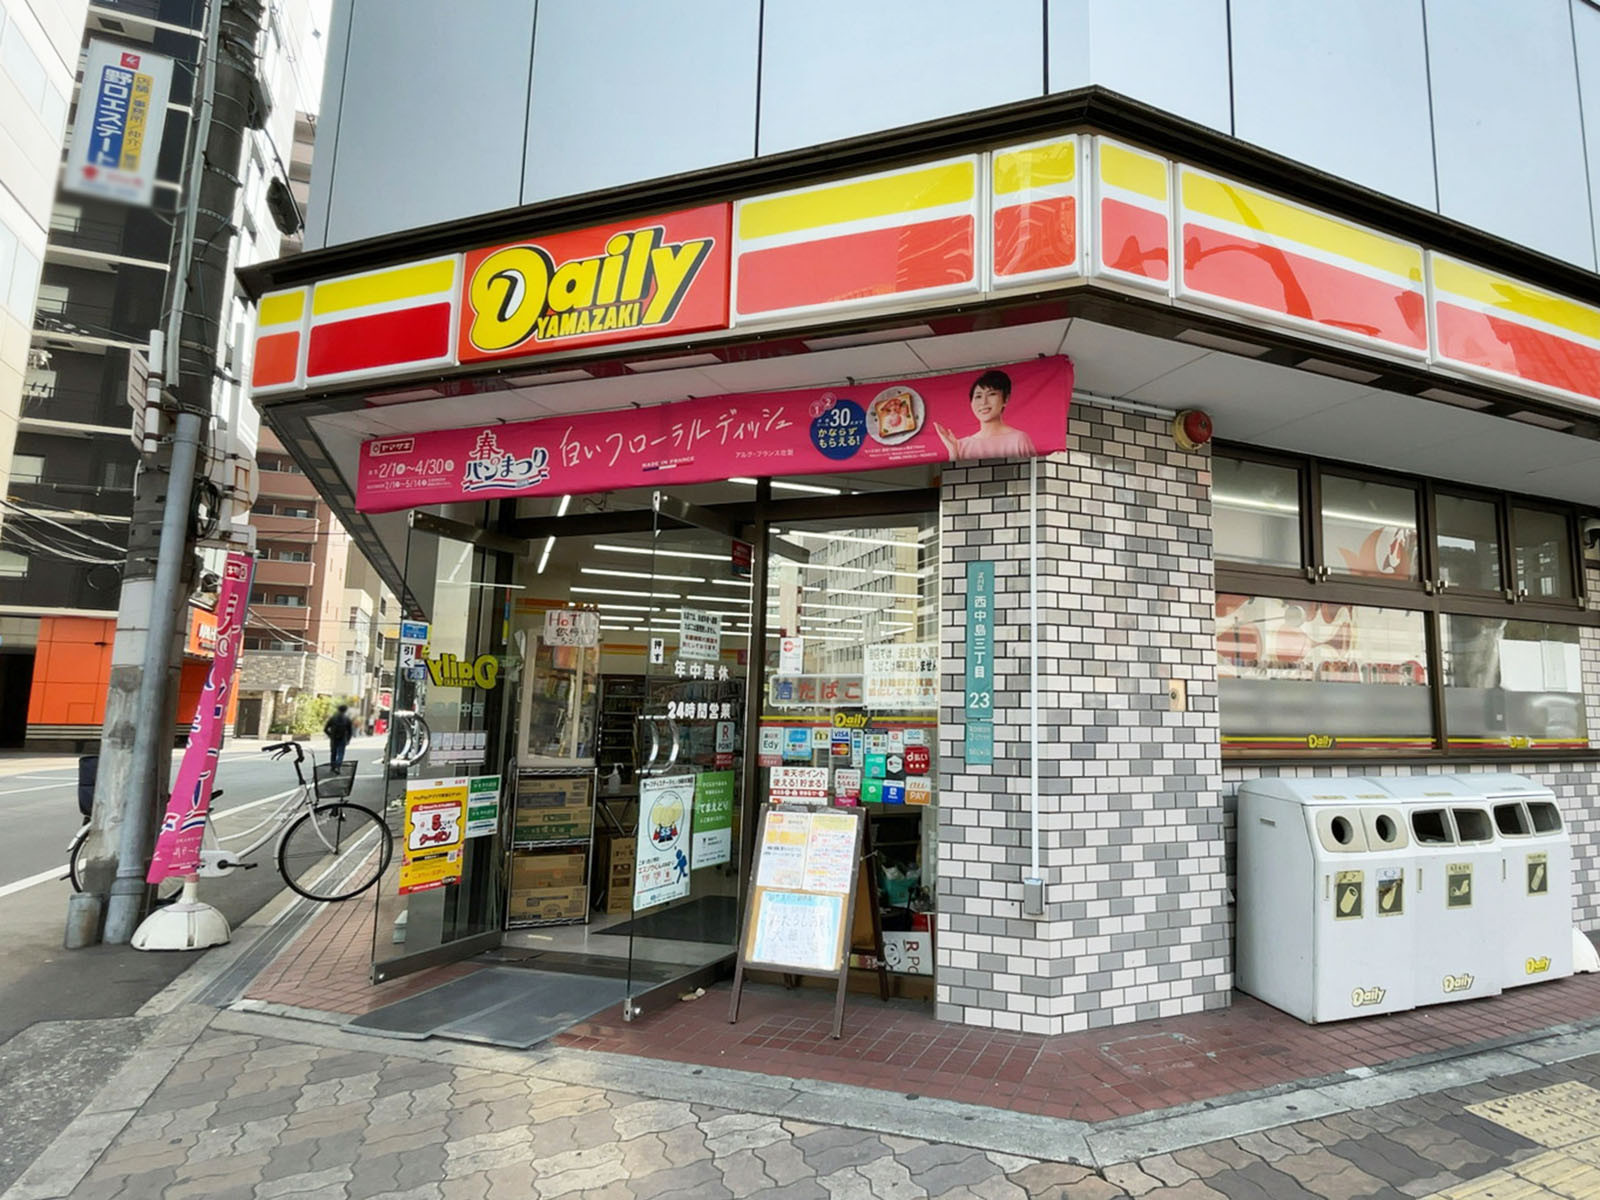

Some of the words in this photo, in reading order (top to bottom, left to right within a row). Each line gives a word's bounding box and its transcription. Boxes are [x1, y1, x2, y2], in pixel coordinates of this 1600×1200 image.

[471, 229, 712, 351] Daily
[538, 303, 641, 340] YAMAZAKI
[830, 407, 851, 427] 30
[559, 406, 794, 467] 白いフローラルディッシュ
[818, 427, 858, 438] かならず
[466, 448, 548, 481] パンまつり
[974, 596, 987, 679] 西中島三丁目
[403, 645, 414, 667] 引く
[674, 660, 729, 682] 年中無休
[798, 680, 860, 699] たばこ
[667, 701, 731, 719] 24時間営業
[969, 692, 990, 709] 23
[833, 712, 868, 727] Daily
[763, 740, 779, 750] Edy
[1308, 735, 1335, 748] Daily
[909, 792, 927, 800] PAY
[906, 941, 920, 952] R
[1526, 956, 1552, 975] Daily
[1443, 973, 1475, 993] Daily
[1351, 987, 1386, 1008] Daily
